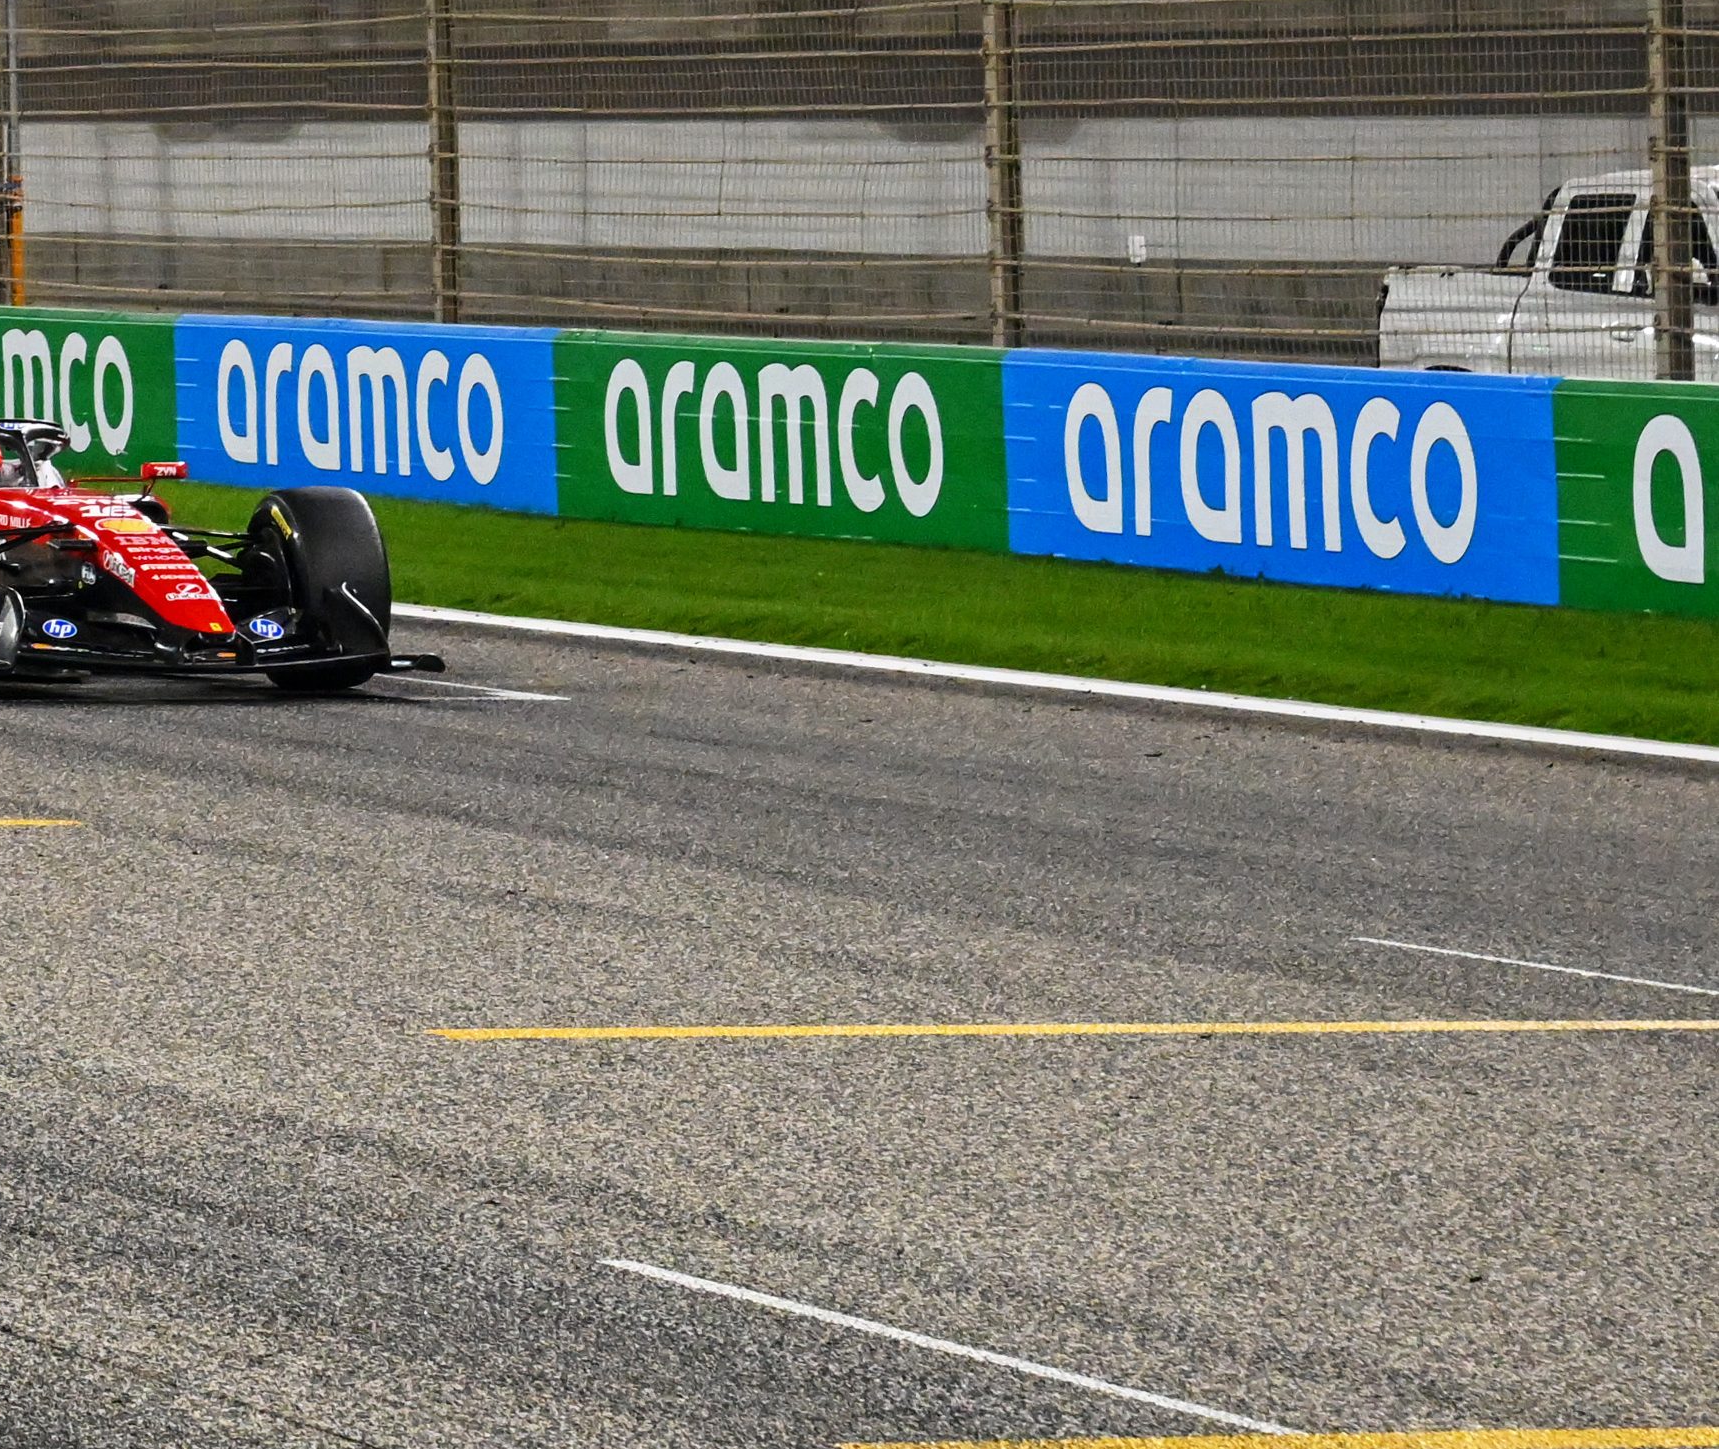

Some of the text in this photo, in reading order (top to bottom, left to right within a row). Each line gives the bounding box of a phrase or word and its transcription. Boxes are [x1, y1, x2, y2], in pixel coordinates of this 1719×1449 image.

[218, 339, 503, 485] aramco
[605, 358, 944, 517] aramco
[1064, 382, 1477, 564] aramco
[79, 505, 138, 517] 16
[9, 513, 32, 528] MILLE
[114, 536, 175, 546] IBM
[49, 619, 72, 637] hp
[257, 619, 278, 637] hp
